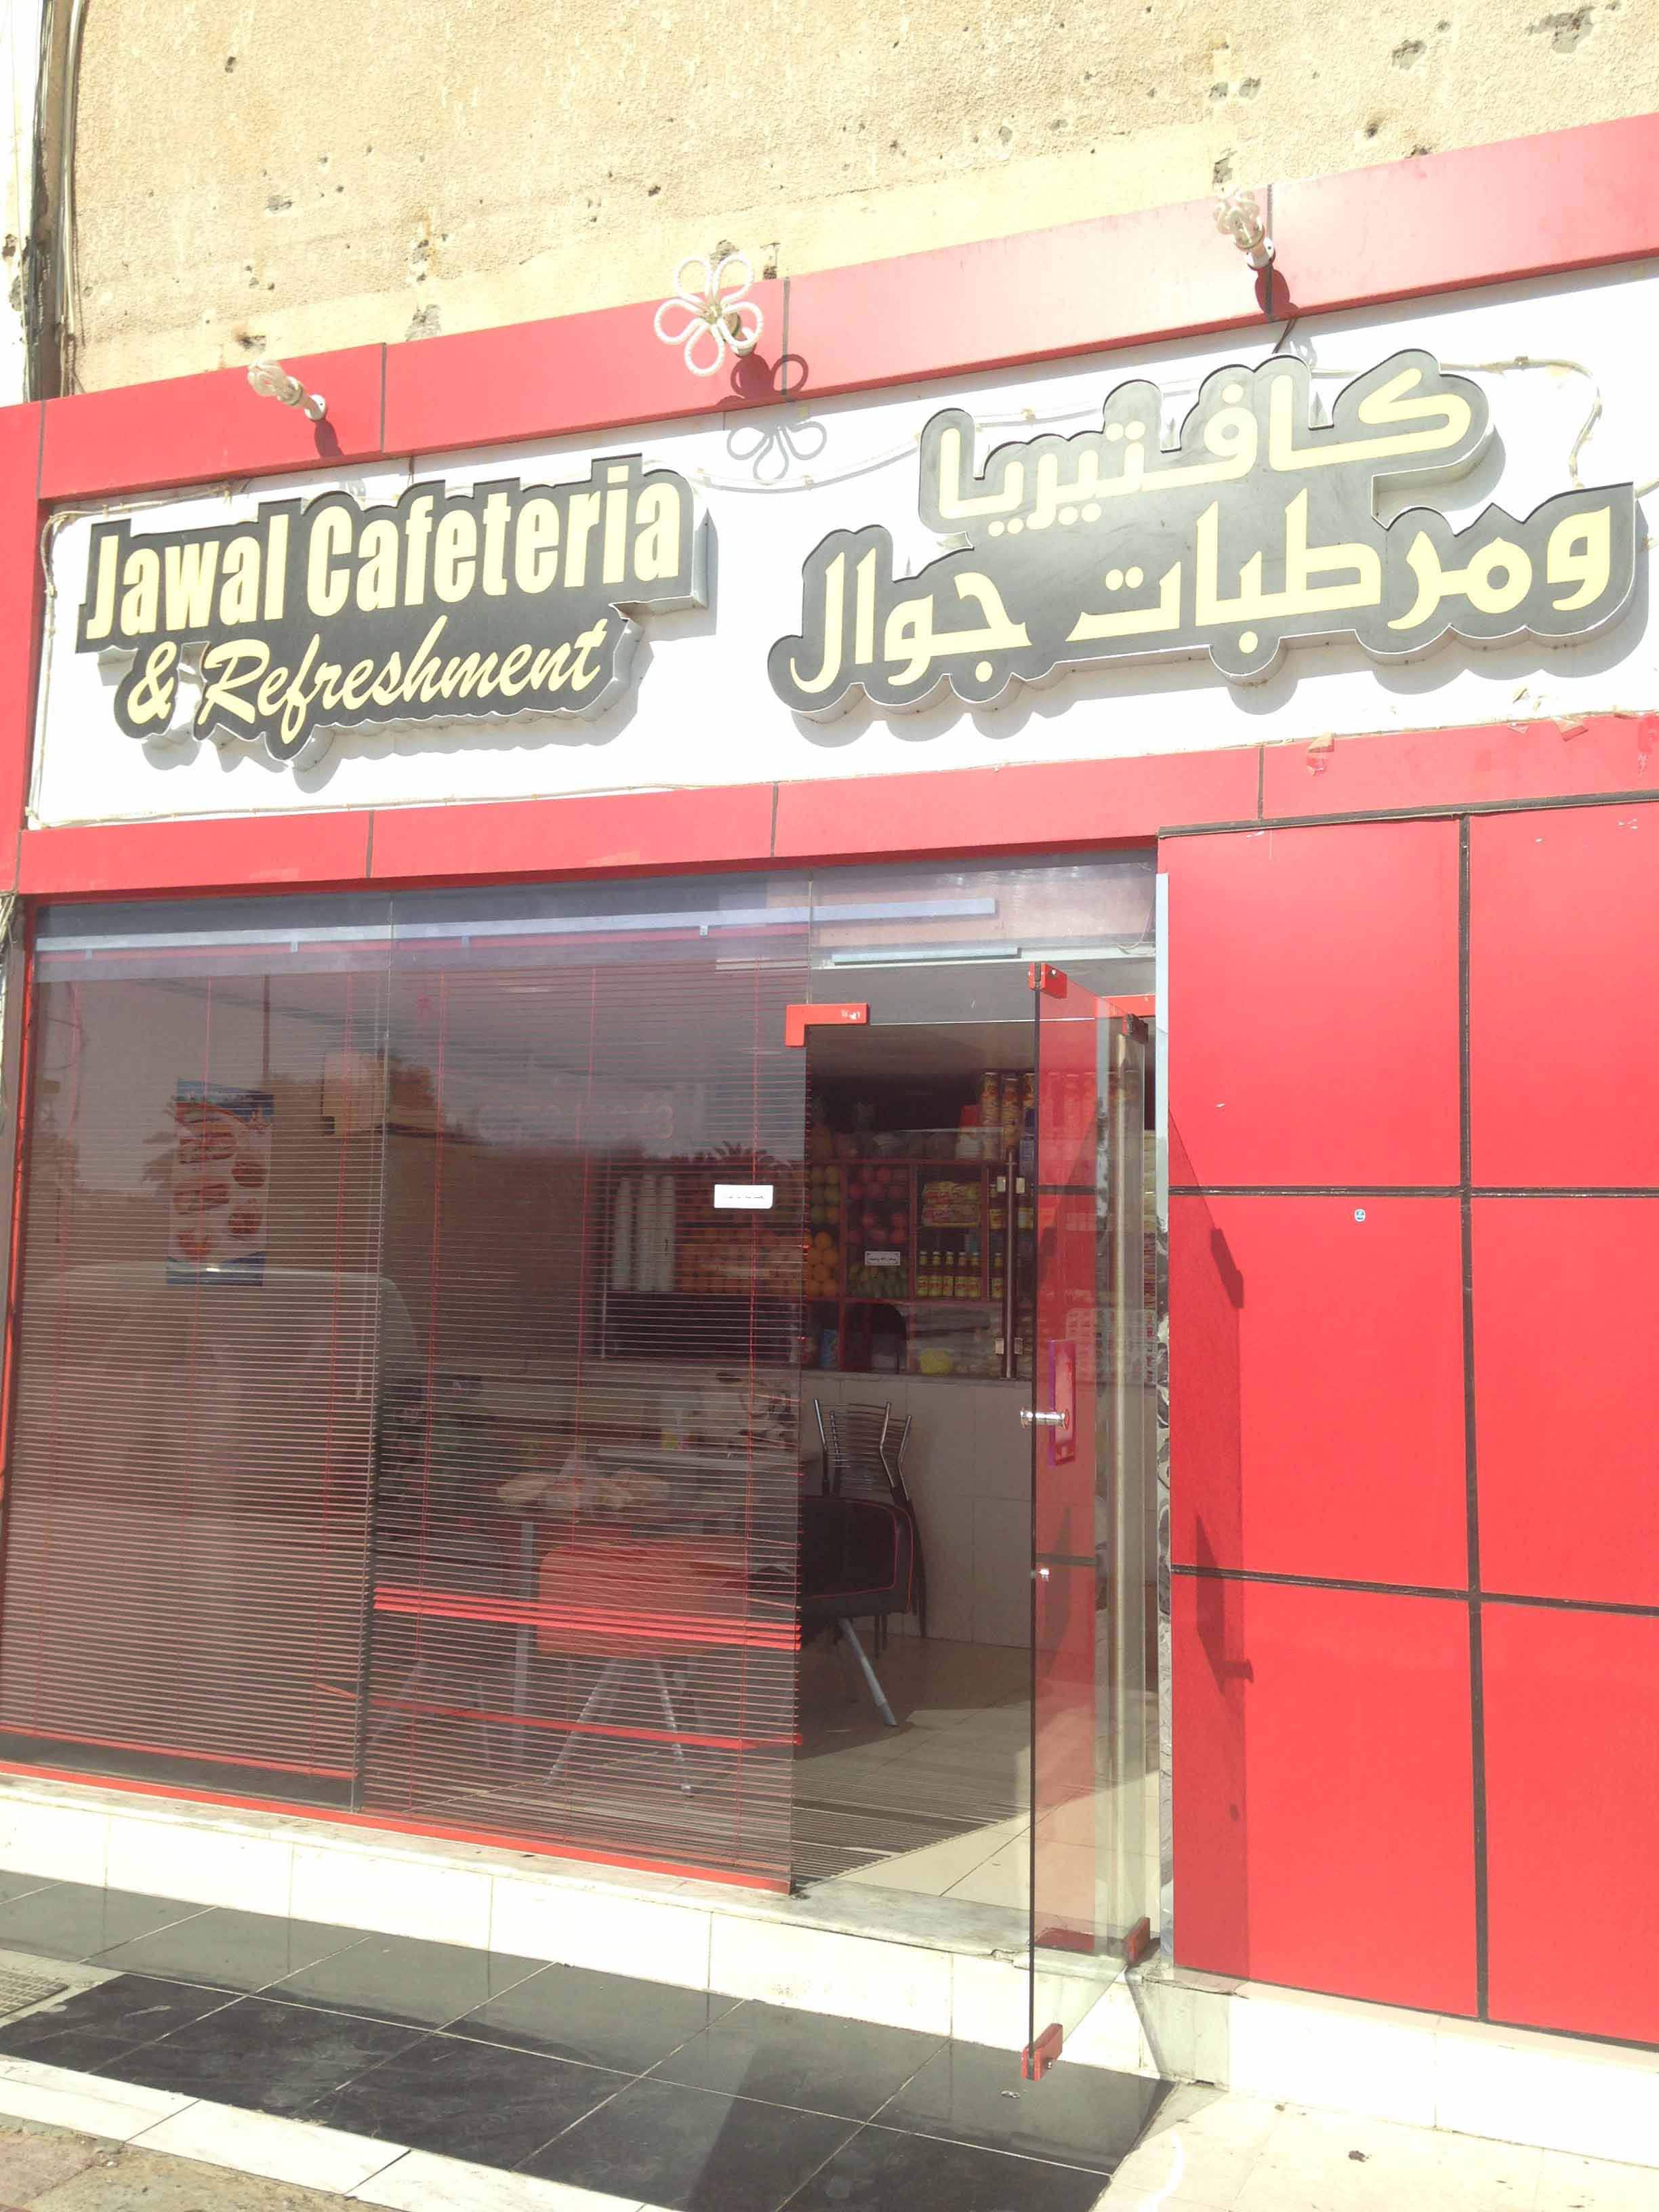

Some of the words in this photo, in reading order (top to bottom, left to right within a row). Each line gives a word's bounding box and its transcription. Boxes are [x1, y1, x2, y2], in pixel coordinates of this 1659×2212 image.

[939, 367, 1472, 538] كافتيريا
[86, 514, 290, 640] Jawal
[306, 465, 682, 618] Cafeteria
[790, 546, 1032, 693] جوال
[1065, 489, 1612, 654] ومرطبات
[127, 640, 176, 725] &
[199, 615, 608, 744] Refreshment
